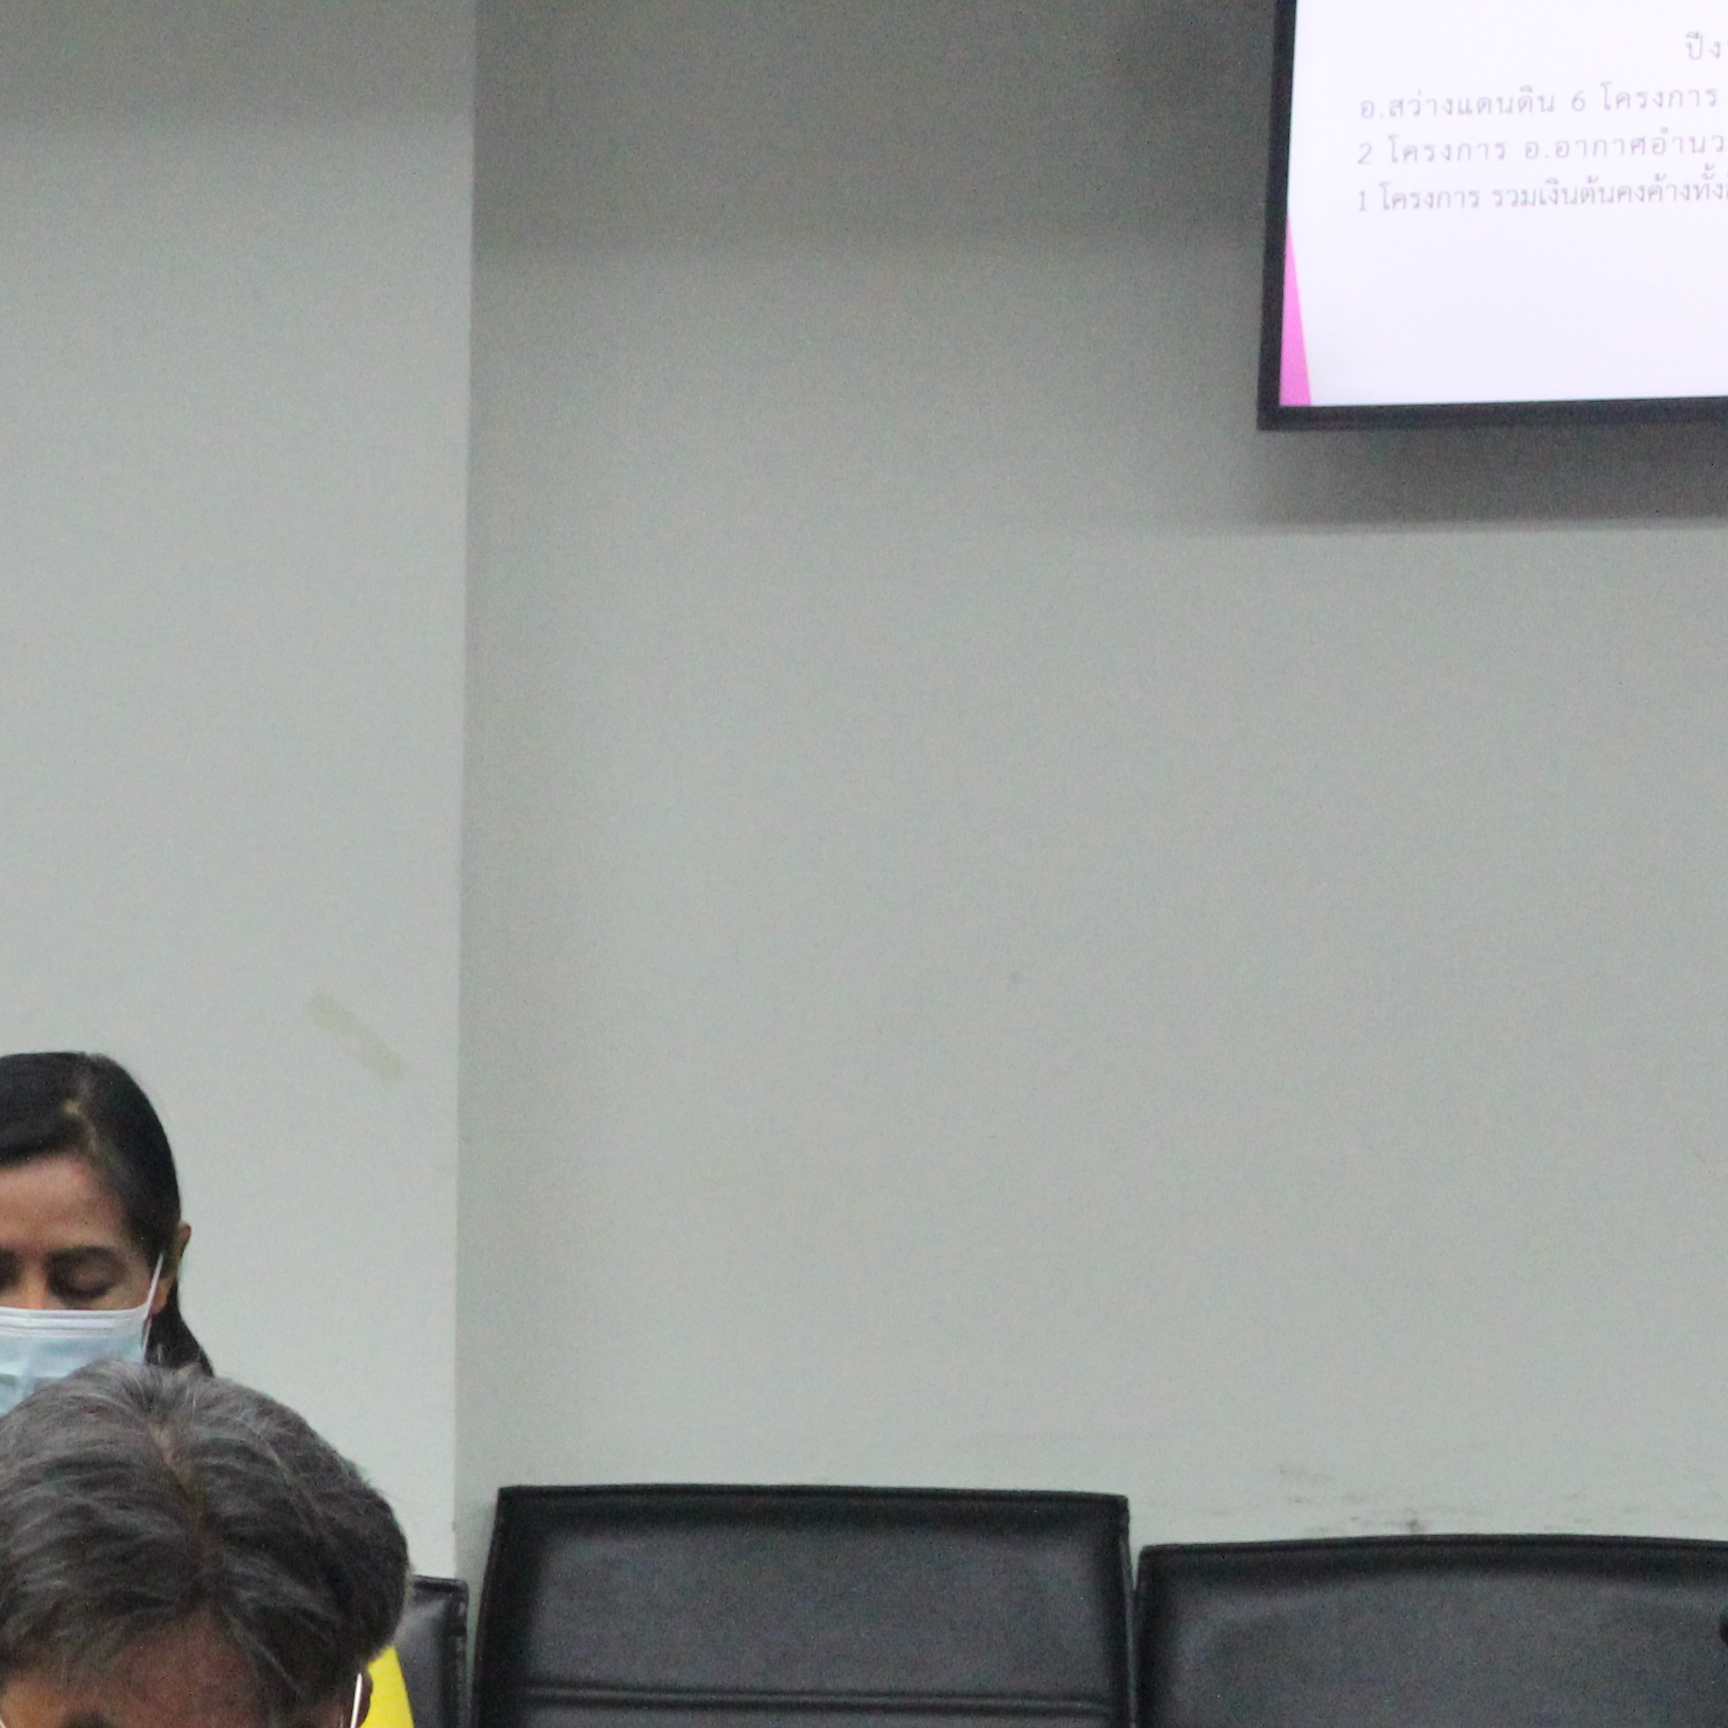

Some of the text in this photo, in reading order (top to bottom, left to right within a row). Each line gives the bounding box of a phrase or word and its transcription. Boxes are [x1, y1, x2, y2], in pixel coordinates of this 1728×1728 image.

[1685, 30, 1728, 61] ปีง
[1360, 81, 1718, 119] อ.สว่างแดนดิน 6 โครงการ
[1357, 141, 1373, 165] 2
[1387, 134, 1506, 164] โครงการ
[1358, 162, 1728, 212] 1 โครงการ รวมเงินต้นคงค้างทั้ง
